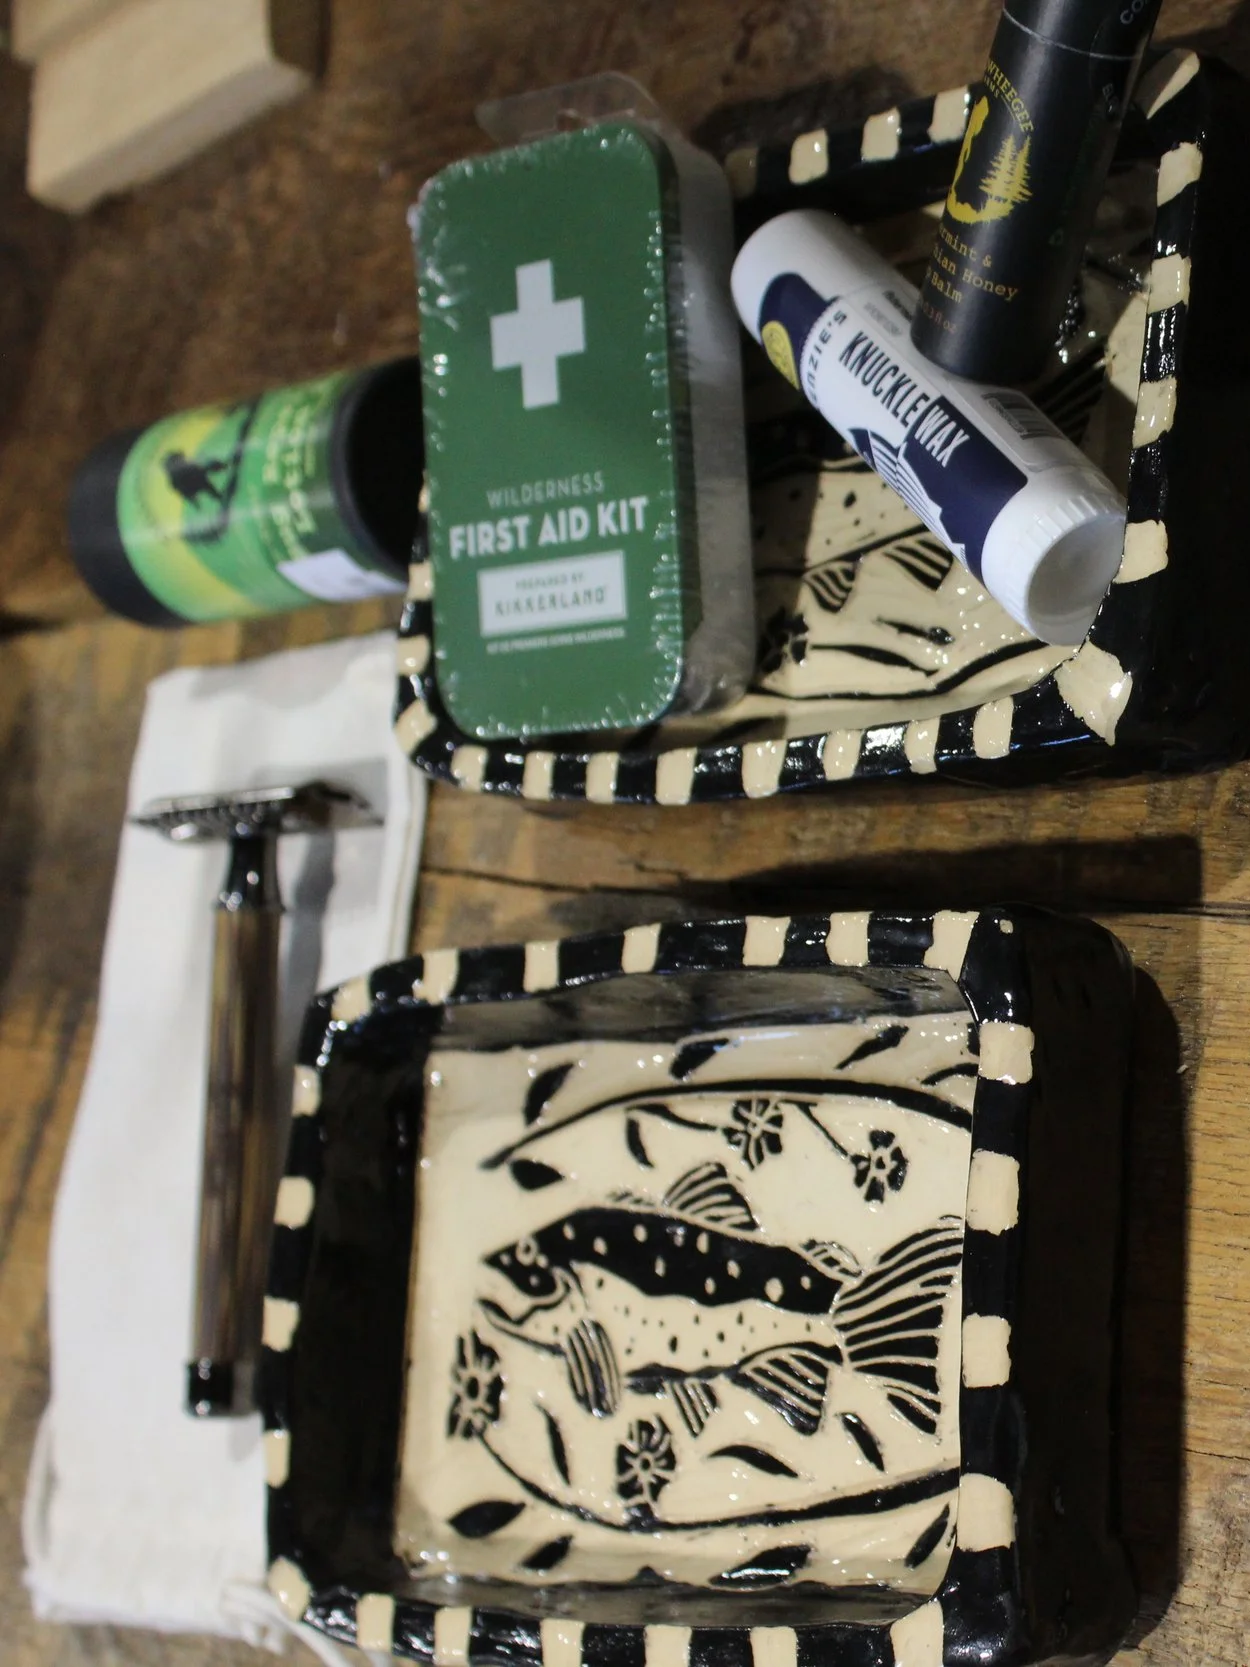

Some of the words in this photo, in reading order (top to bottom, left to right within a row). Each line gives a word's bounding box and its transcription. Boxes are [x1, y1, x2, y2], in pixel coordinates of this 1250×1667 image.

[982, 254, 992, 268] &
[931, 271, 963, 304] Balm
[962, 268, 1018, 302] Honey
[839, 330, 930, 428] KNUCKLE
[914, 404, 970, 468] WAX
[486, 471, 605, 509] WILDERNESS
[450, 514, 531, 561] FIRST
[538, 506, 590, 547] AID
[597, 495, 649, 538] KIT
